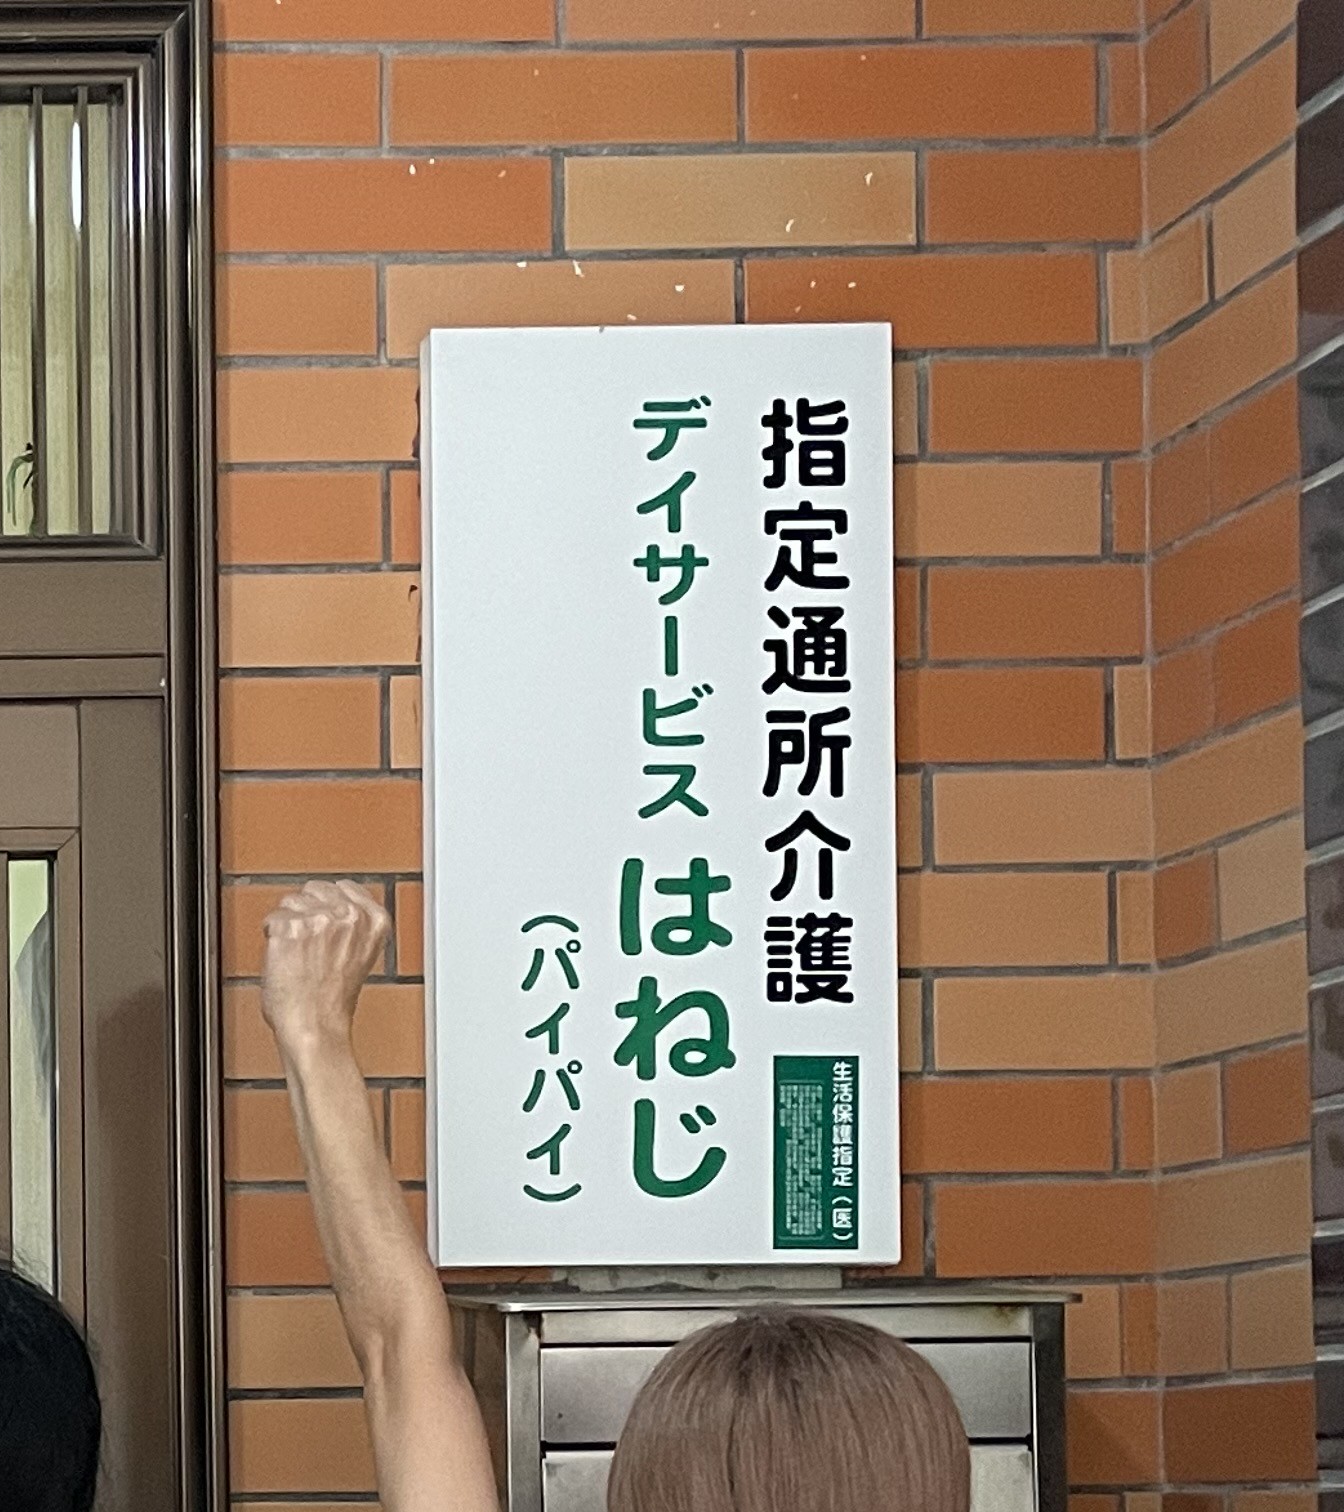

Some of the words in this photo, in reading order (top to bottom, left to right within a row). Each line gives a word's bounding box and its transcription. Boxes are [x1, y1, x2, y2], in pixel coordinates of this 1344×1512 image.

[631, 393, 715, 821] デイサービス
[760, 397, 855, 1005] 指定通所介護
[613, 854, 737, 1200] はねじ
